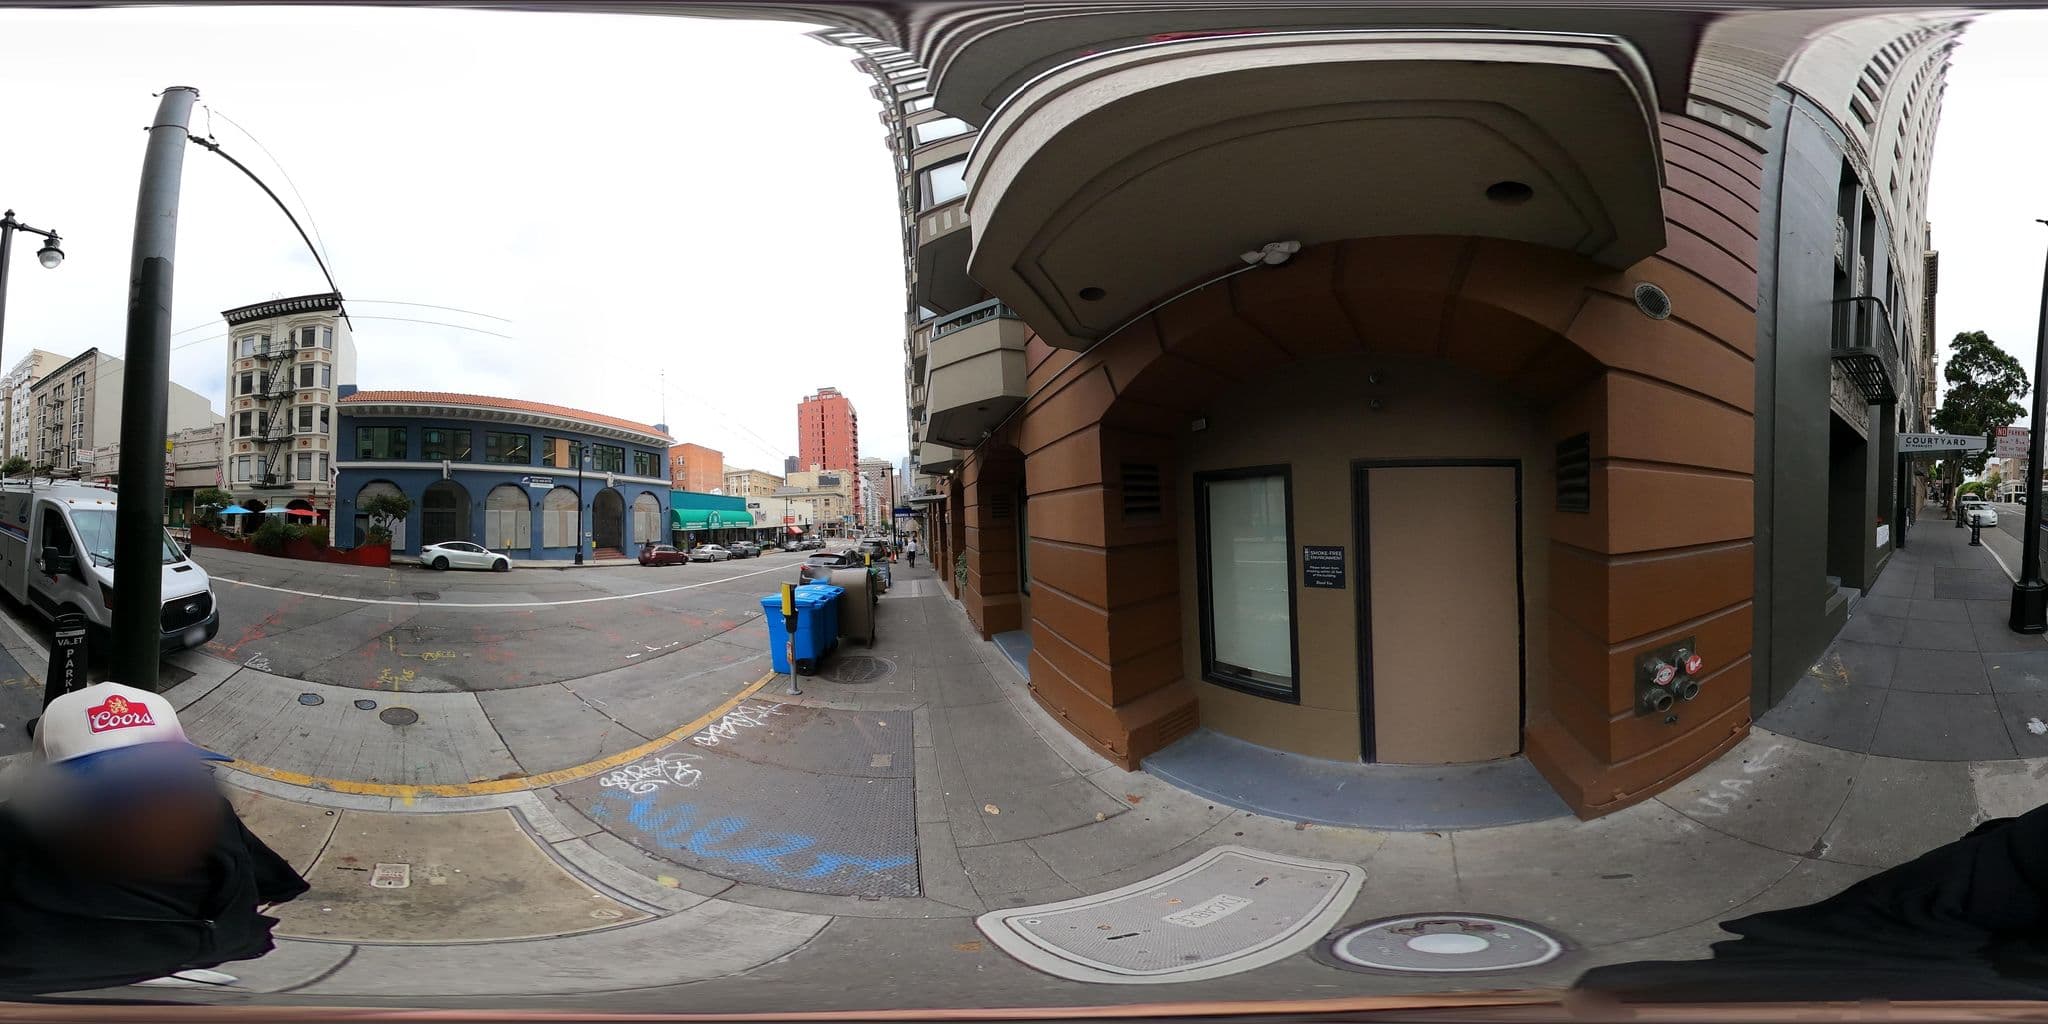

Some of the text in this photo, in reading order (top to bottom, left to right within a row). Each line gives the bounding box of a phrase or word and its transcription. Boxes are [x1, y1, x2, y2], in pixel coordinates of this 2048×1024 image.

[1997, 428, 2007, 437] NO
[1906, 437, 1967, 446] COURTYARD
[91, 711, 151, 729] Coors
